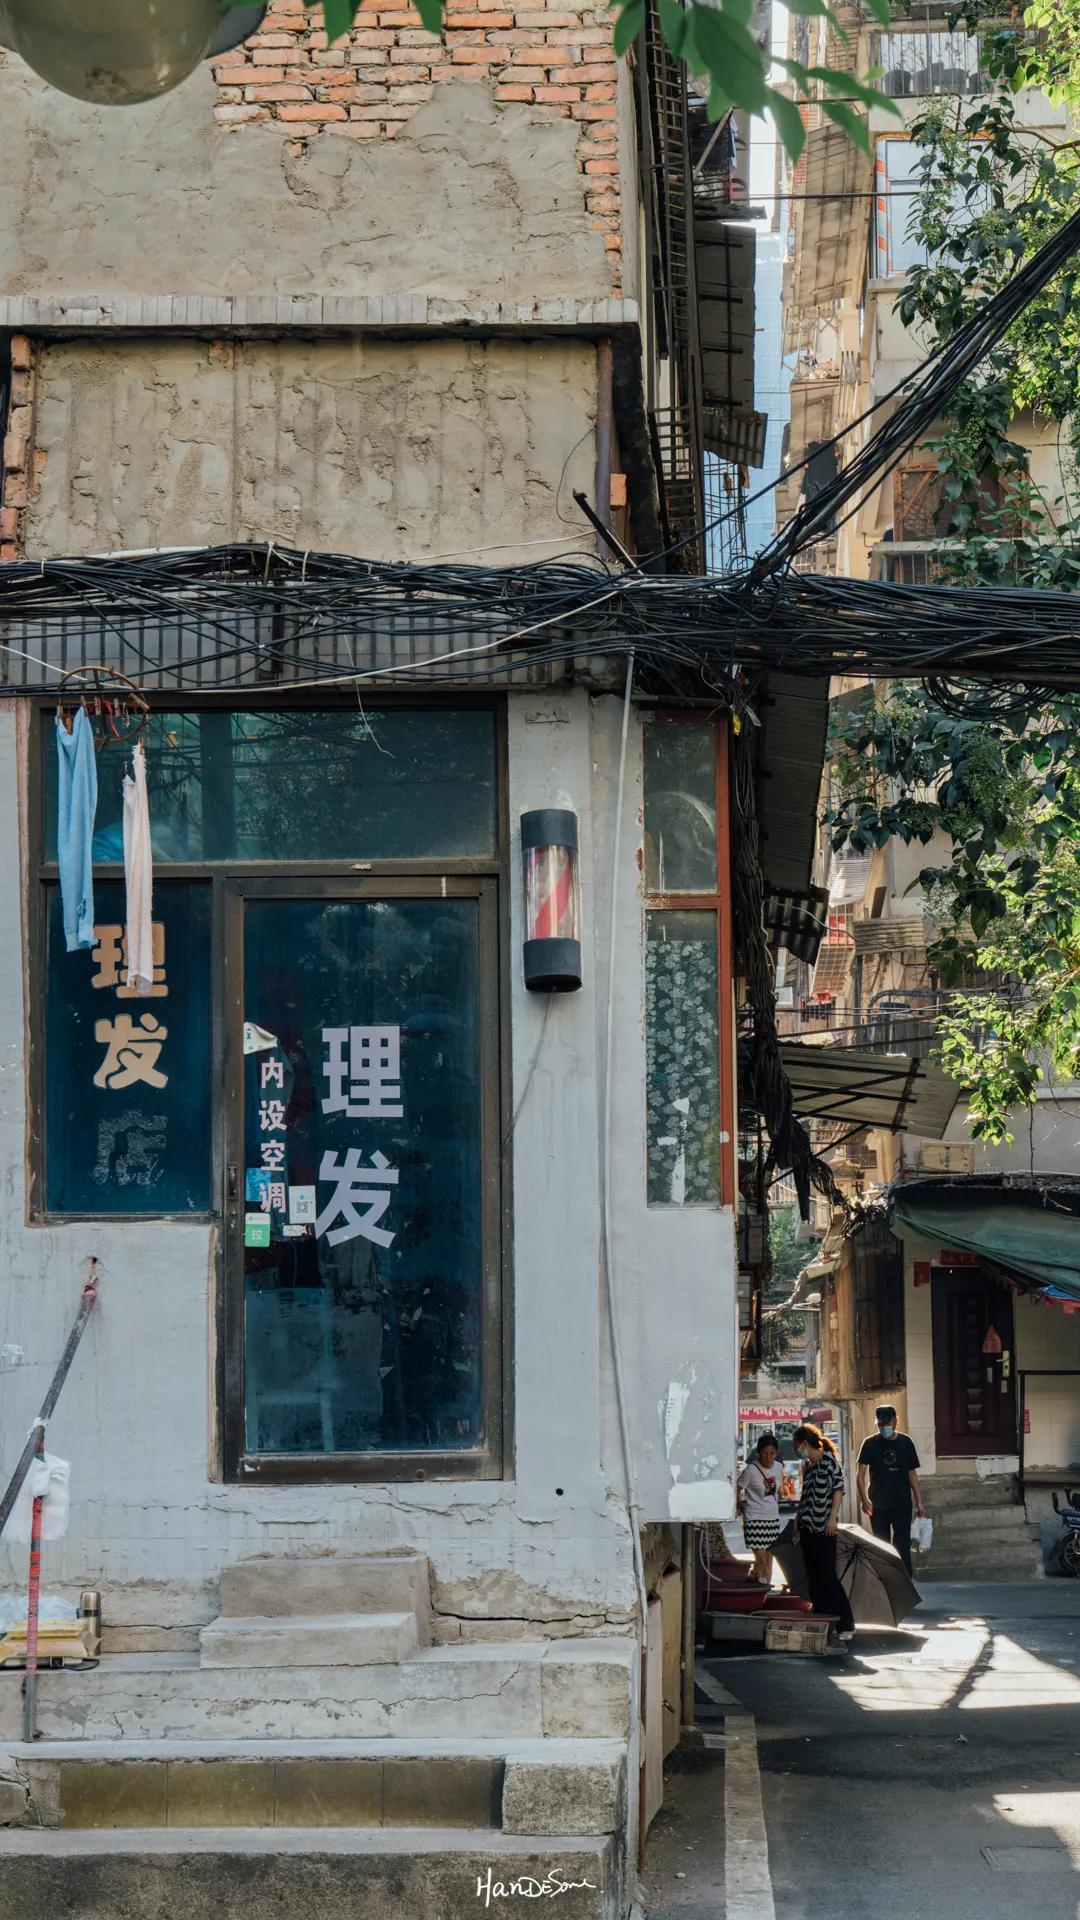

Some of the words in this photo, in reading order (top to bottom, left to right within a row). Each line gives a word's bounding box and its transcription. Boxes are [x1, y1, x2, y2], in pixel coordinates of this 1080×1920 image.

[258, 1056, 288, 1213] 内设空调
[315, 1025, 404, 1249] 理发
